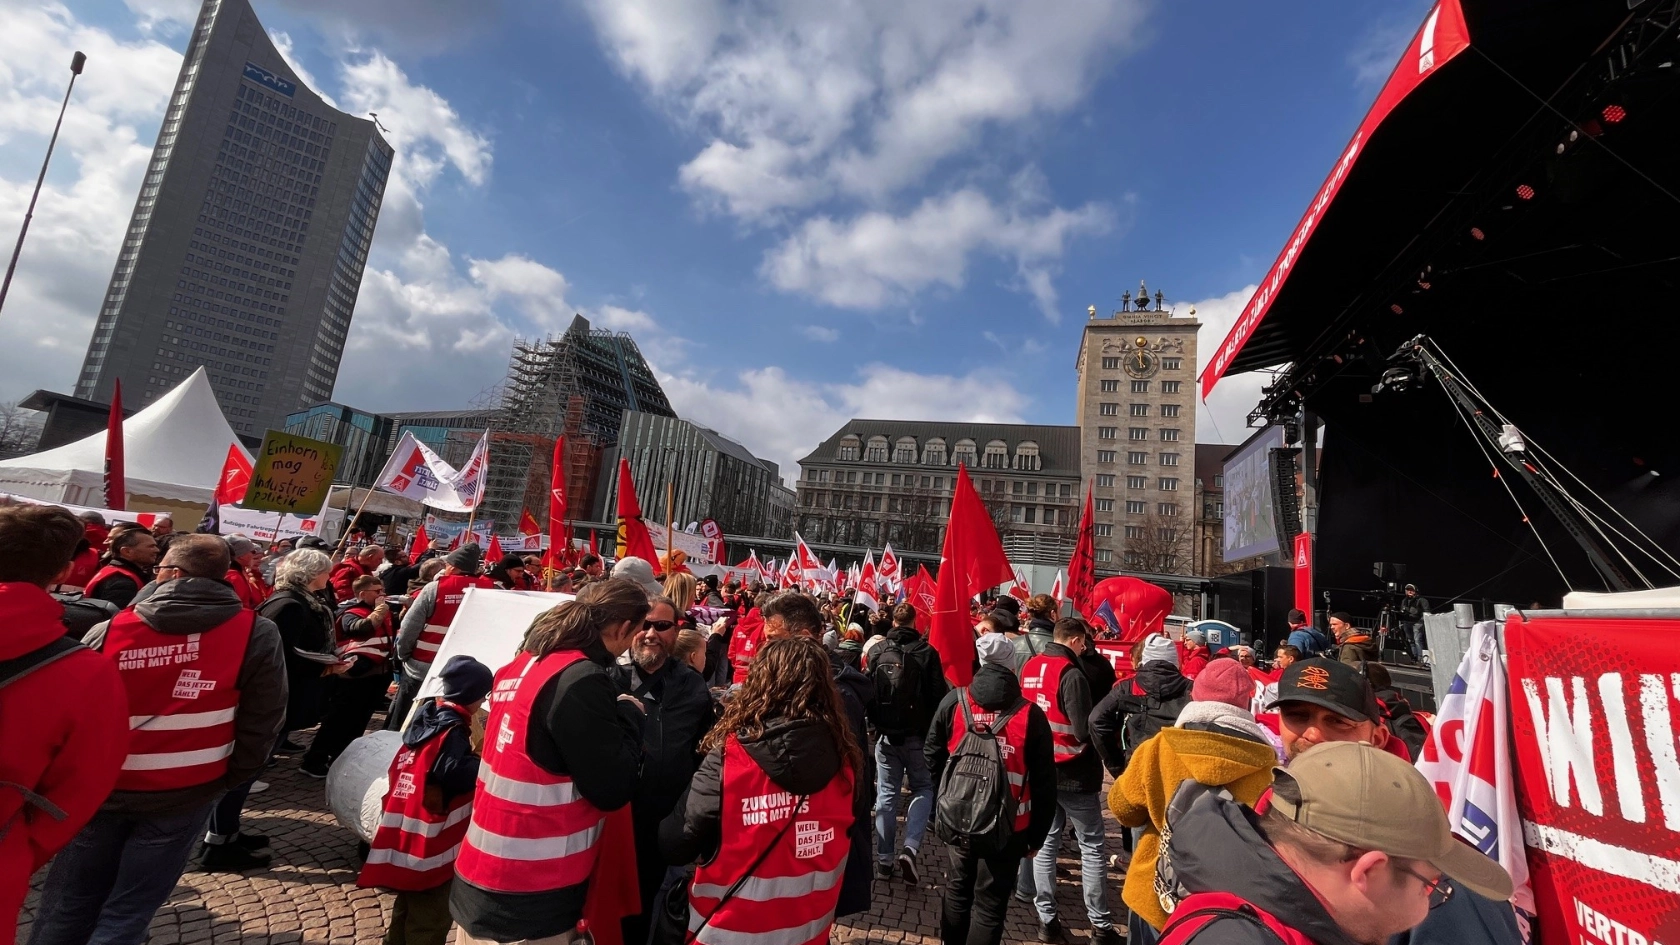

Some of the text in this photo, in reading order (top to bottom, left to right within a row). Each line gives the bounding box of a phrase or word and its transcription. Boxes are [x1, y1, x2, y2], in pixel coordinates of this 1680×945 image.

[267, 440, 318, 461] Einhorn
[272, 460, 302, 474] mag
[254, 474, 314, 497] Industrie-
[253, 491, 297, 508] politik
[223, 519, 245, 528] Aufzüge
[119, 644, 184, 660] ZUKUNFT
[119, 652, 199, 670] NUR MIT UNS
[181, 670, 197, 679] WEIL
[177, 680, 214, 689] DAS JETZT
[742, 811, 768, 826] NUR
[769, 807, 790, 823] MIT
[797, 824, 817, 833] WEIL
[798, 831, 833, 846] DAS JETZT
[797, 846, 821, 858] ZÄHLT.
